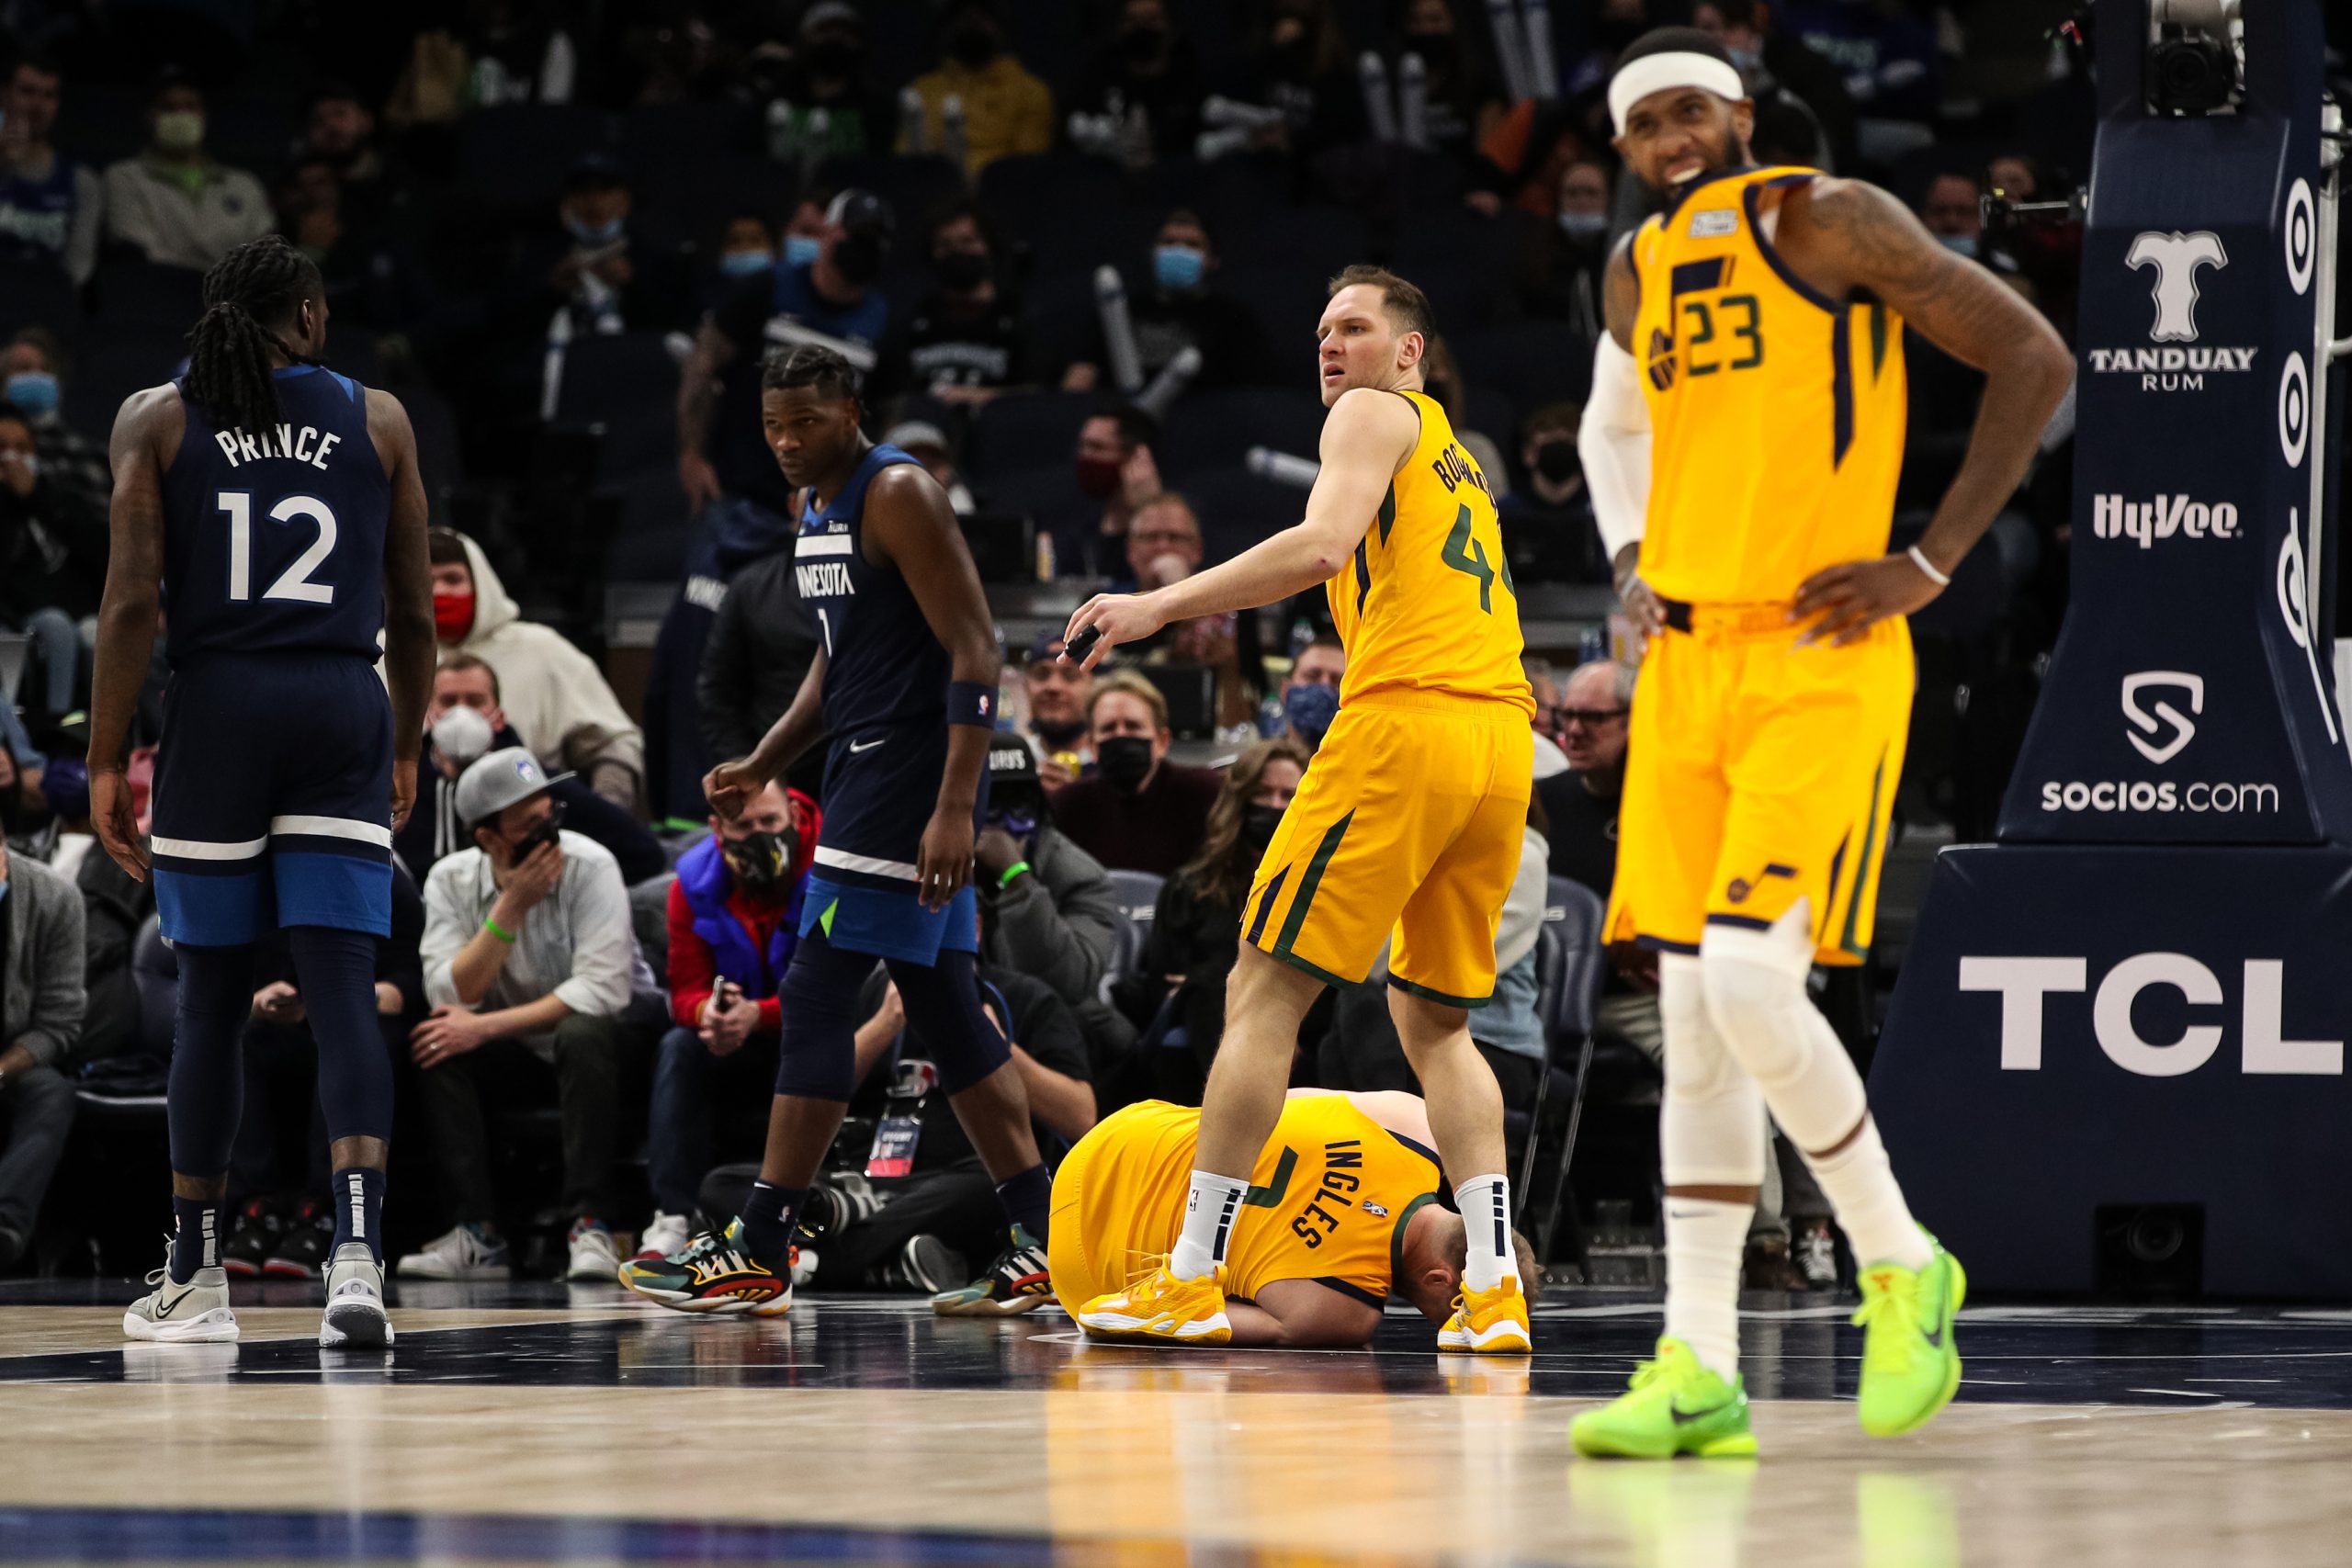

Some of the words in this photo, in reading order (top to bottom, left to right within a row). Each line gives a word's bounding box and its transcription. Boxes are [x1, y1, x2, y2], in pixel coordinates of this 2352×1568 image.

[1684, 294, 1763, 377] 23
[2088, 346, 2258, 373] TANDUAY
[2142, 373, 2204, 392] RUM
[214, 423, 342, 470] PRINCE
[218, 491, 337, 604] 12
[2041, 781, 2279, 813] SOCIOS.com
[1959, 951, 2344, 1077] TCL
[1292, 1140, 1363, 1249] INGLES
